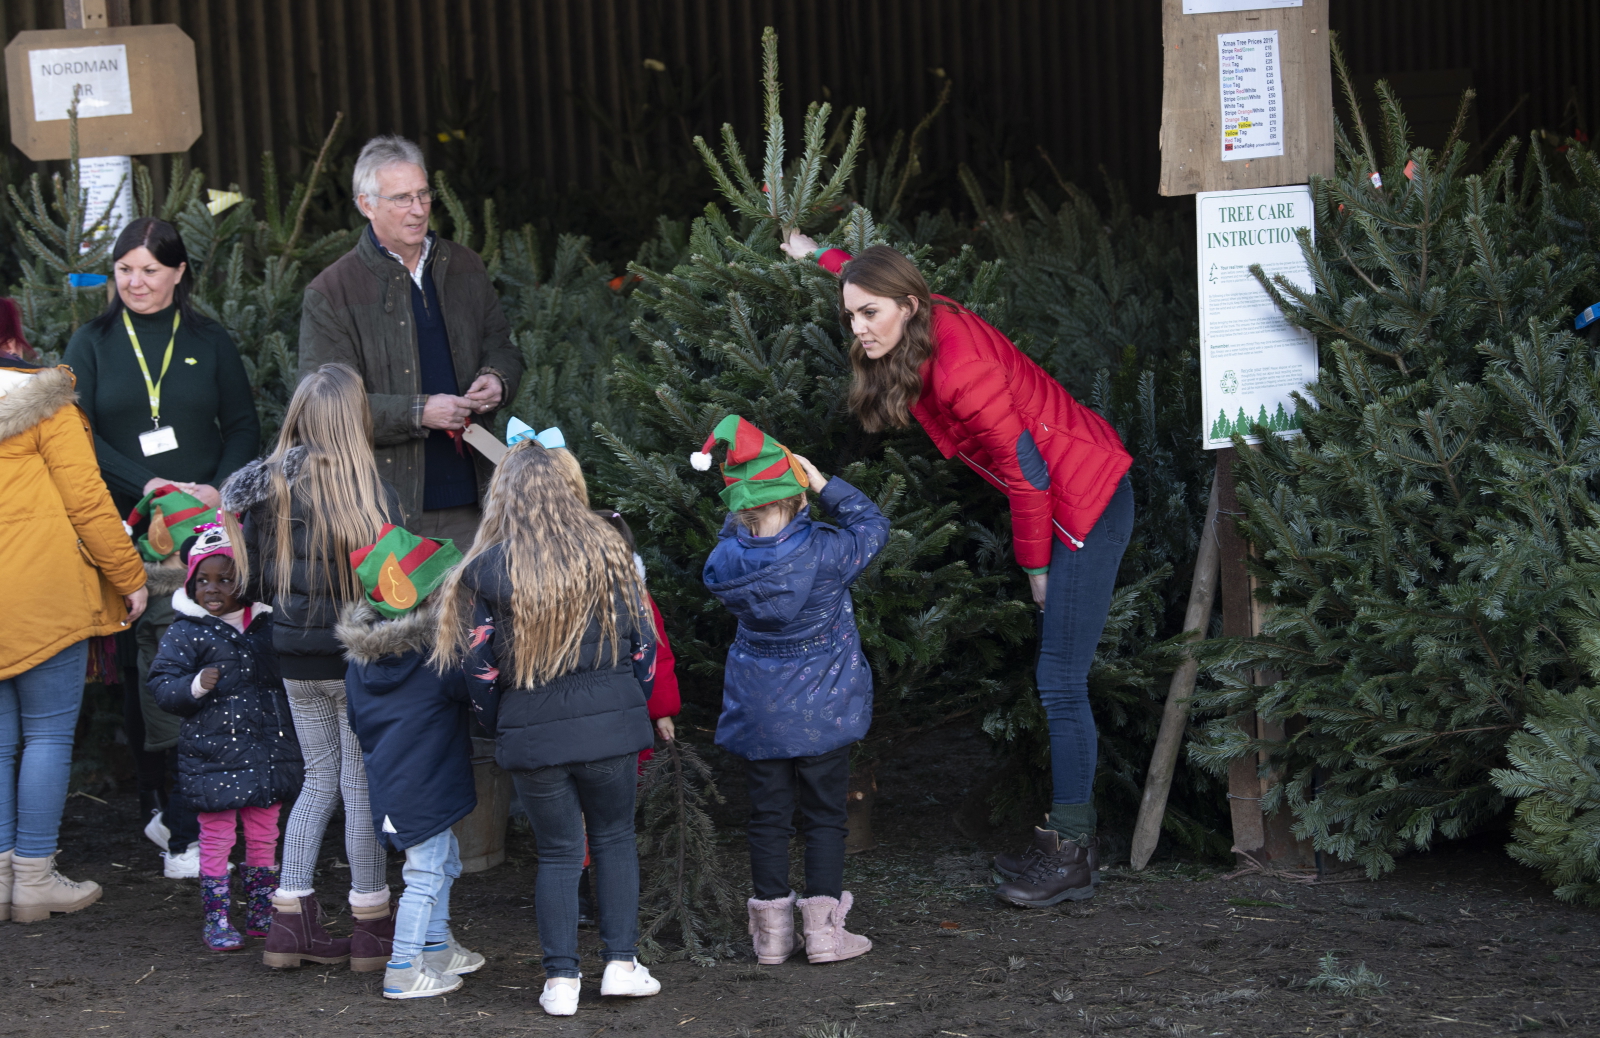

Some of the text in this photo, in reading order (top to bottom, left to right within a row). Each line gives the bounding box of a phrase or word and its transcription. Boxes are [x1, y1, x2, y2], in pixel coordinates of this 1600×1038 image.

[41, 59, 118, 76] NORDMAN
[1219, 203, 1294, 223] TREE CARE
[1207, 226, 1308, 248] INSTRUCTION
